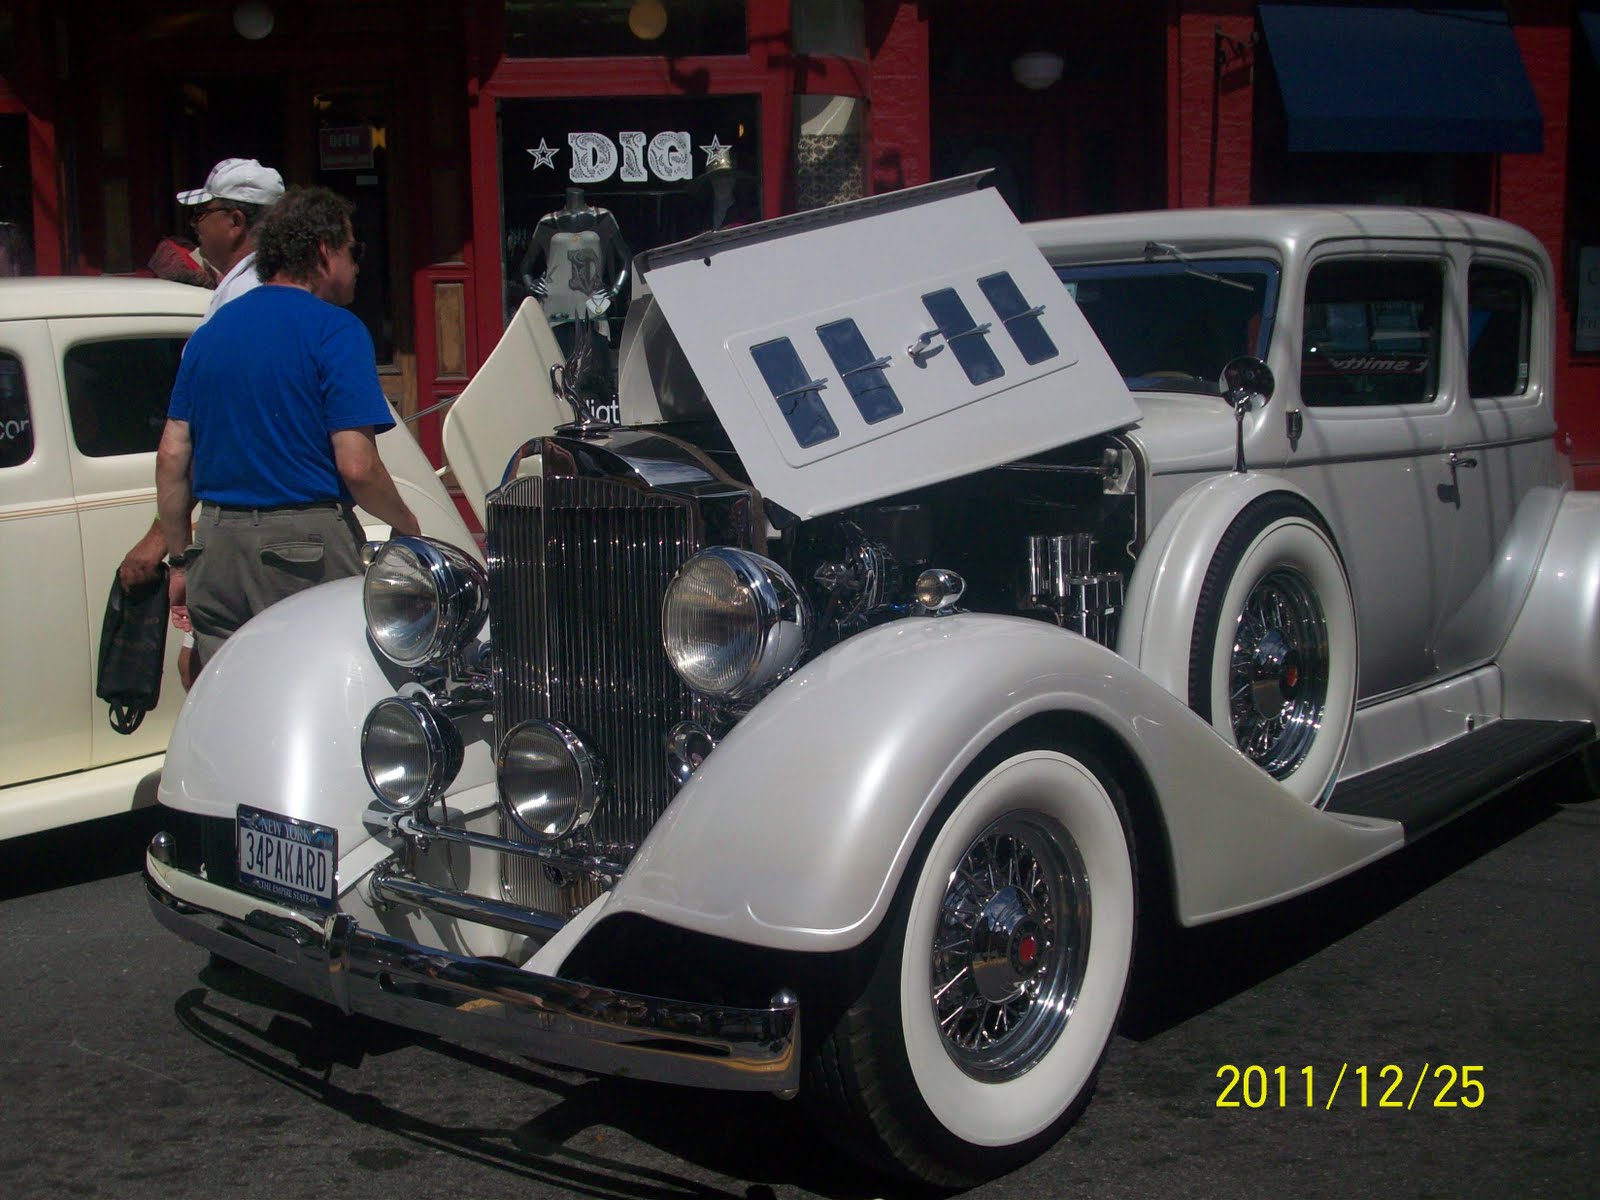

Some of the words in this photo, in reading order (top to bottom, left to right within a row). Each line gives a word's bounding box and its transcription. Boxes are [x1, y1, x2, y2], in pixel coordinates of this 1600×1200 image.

[568, 131, 693, 183] DIG
[261, 817, 281, 834] NEW
[282, 824, 311, 844] YORK
[246, 832, 327, 892] 34PAKARD
[260, 881, 271, 891] THE
[272, 884, 292, 898] EMPIRE
[293, 891, 310, 904] STATE
